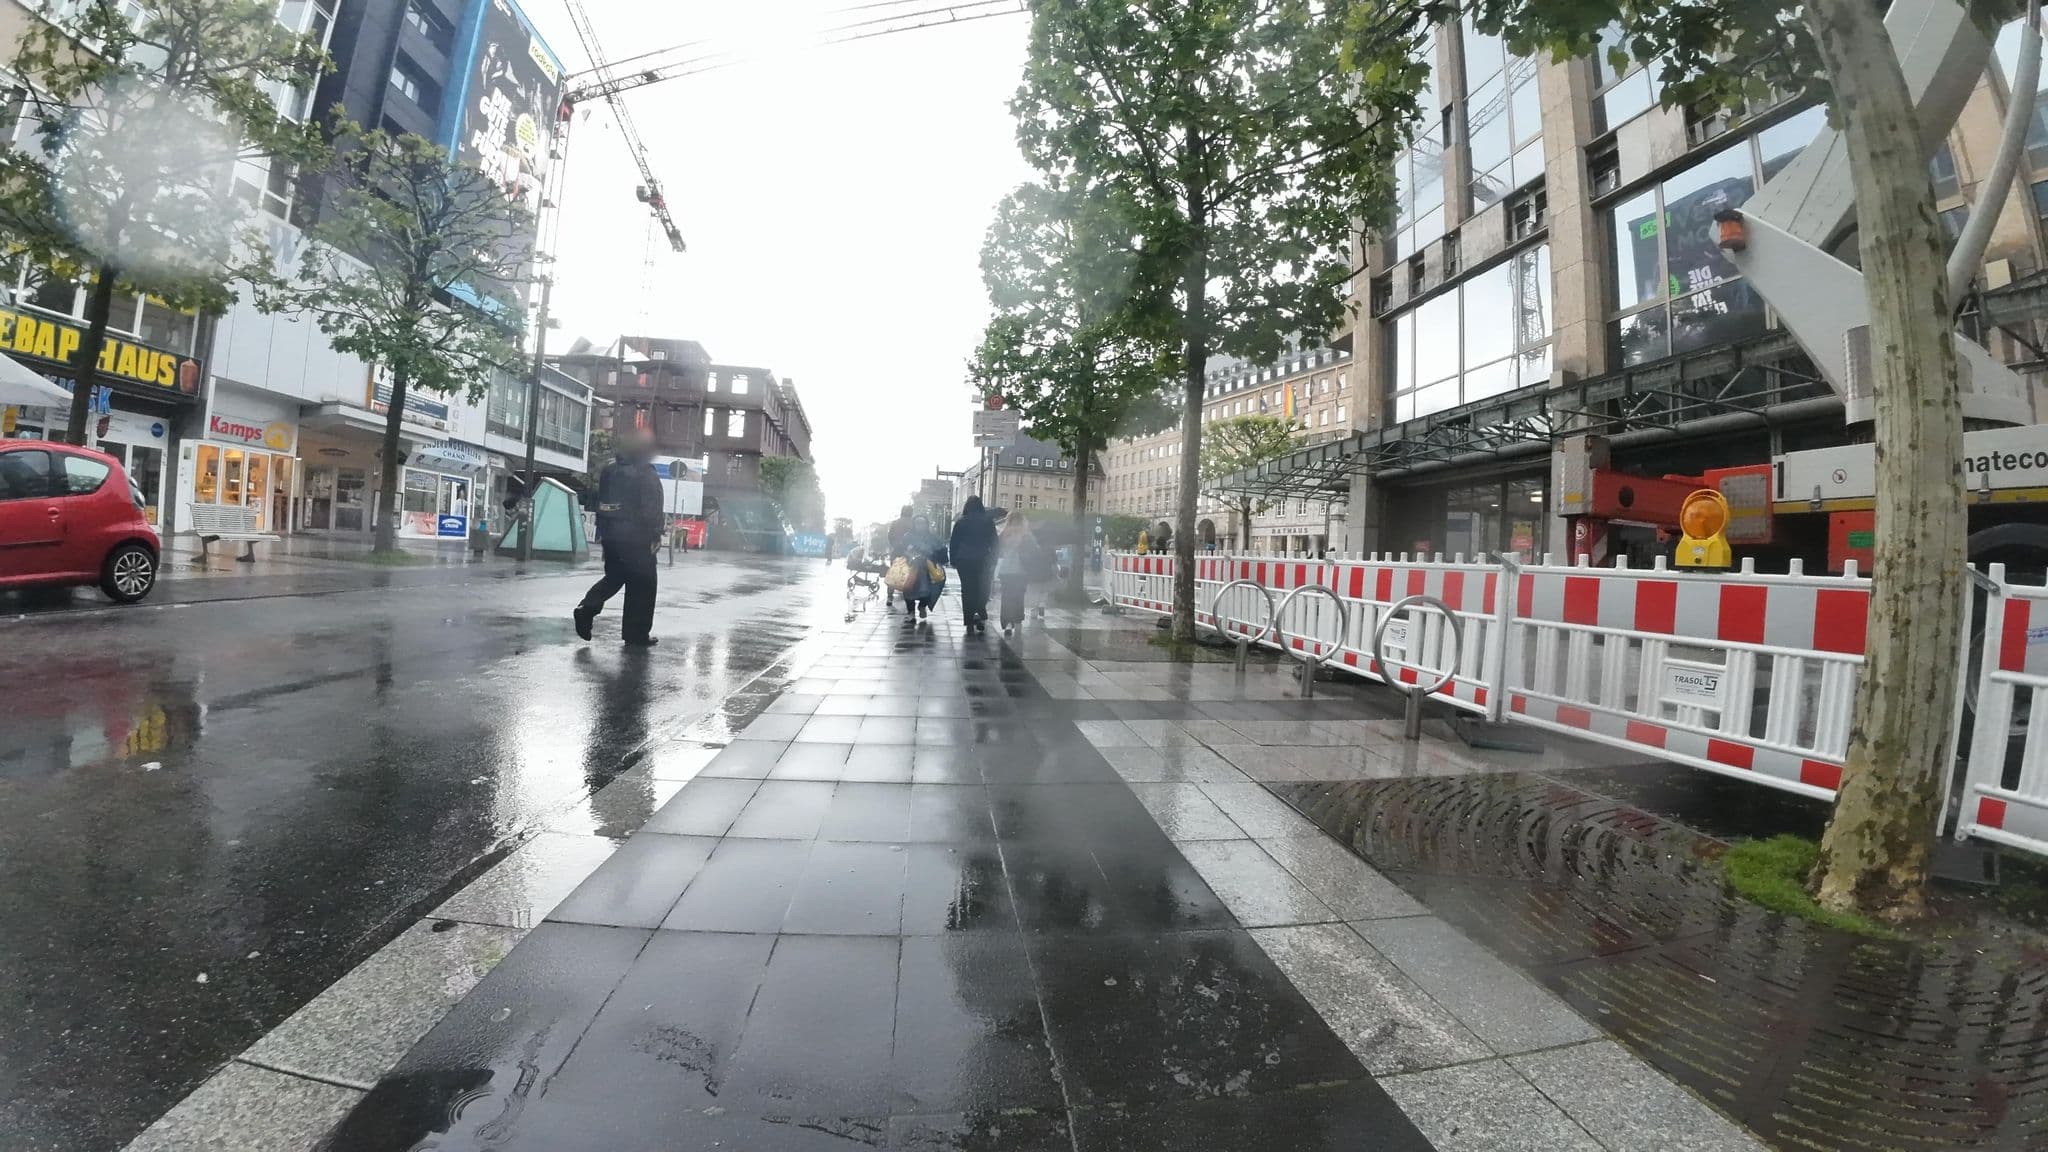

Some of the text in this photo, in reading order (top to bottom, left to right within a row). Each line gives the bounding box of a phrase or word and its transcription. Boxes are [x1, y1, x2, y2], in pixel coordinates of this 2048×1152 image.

[96, 338, 177, 387] HAUS
[210, 415, 262, 442] Kamps
[1674, 675, 1704, 686] TRASOL
